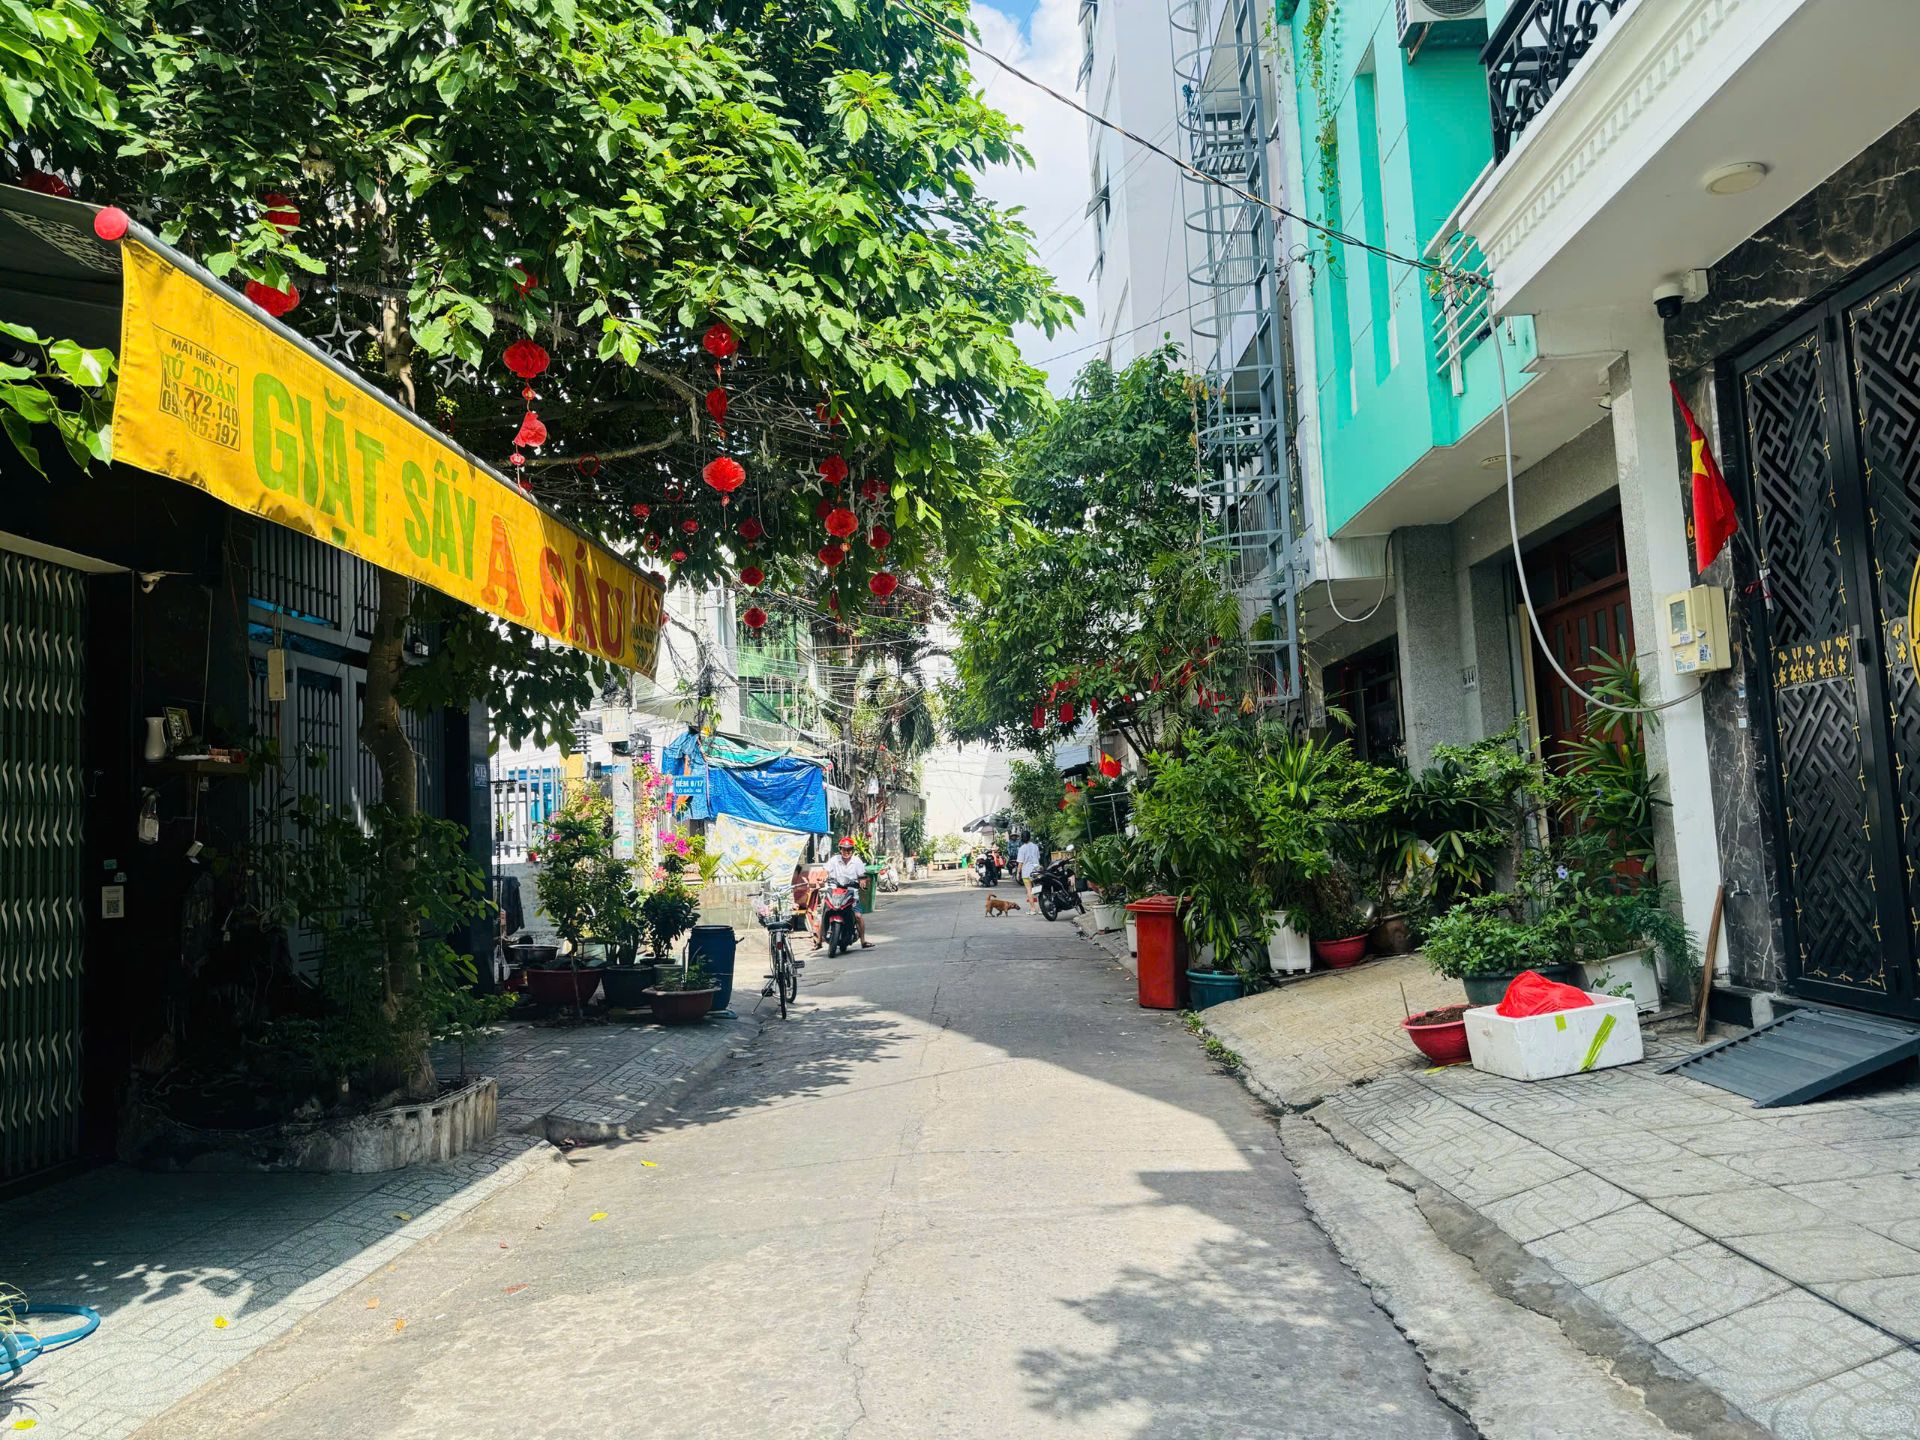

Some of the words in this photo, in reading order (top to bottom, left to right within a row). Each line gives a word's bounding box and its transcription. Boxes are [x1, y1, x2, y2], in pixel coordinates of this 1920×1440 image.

[171, 338, 192, 356] MÁI
[192, 367, 235, 405] TOÀN
[252, 373, 385, 548] GIẶT
[401, 459, 477, 580] SẤY
[480, 515, 526, 618] A
